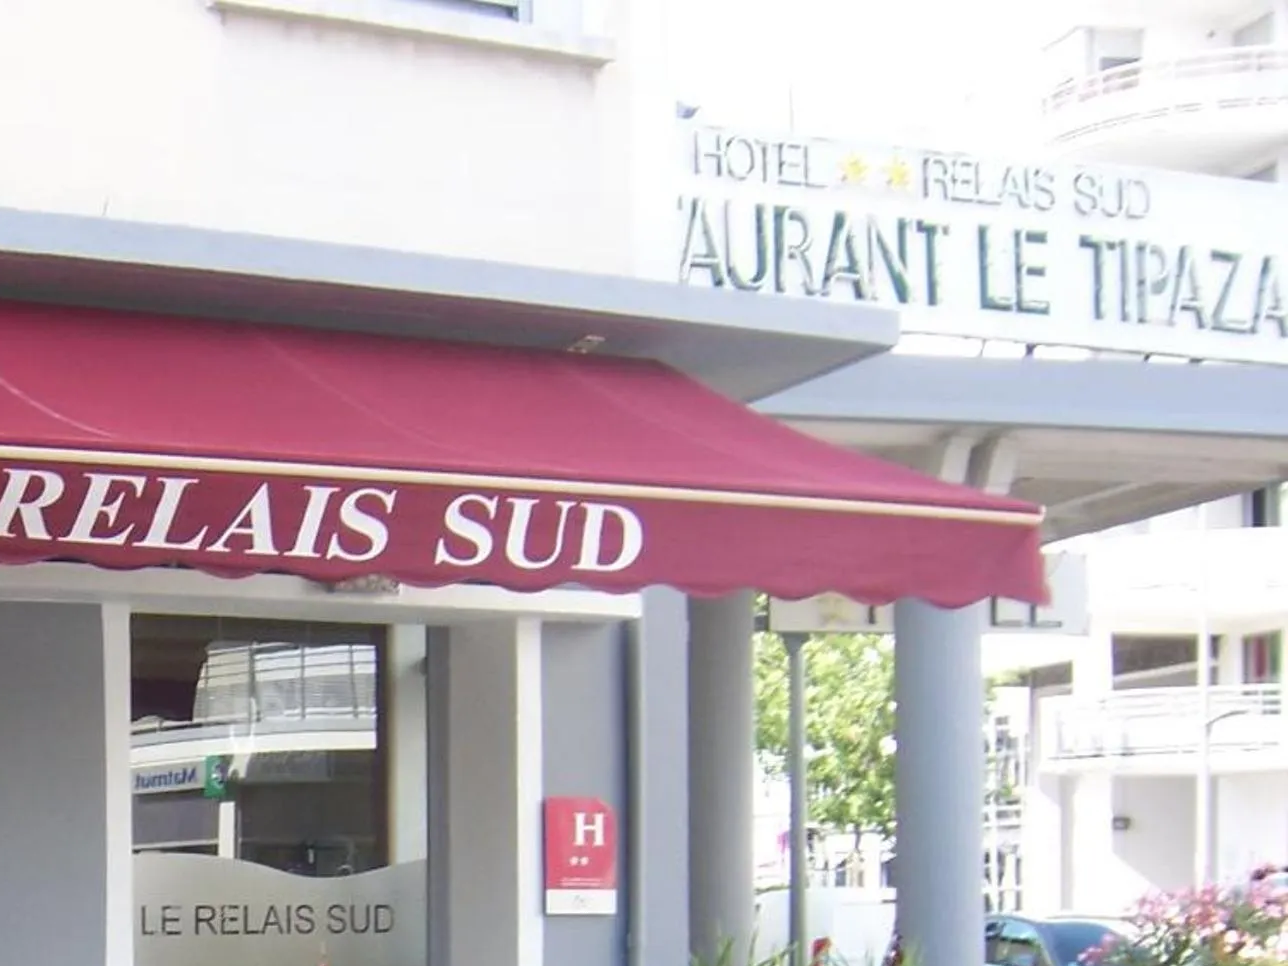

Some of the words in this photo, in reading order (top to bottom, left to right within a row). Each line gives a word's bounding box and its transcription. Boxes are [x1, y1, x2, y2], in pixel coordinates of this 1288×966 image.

[693, 130, 828, 188] HOTEL
[922, 156, 1056, 212] RELAIS
[1073, 171, 1150, 219] SUD
[677, 196, 950, 306] AURANT
[978, 223, 1050, 316] LE
[1079, 234, 1288, 338] TIPAZA
[434, 493, 644, 573] SUD
[573, 811, 605, 847] H
[140, 904, 183, 936] LE
[194, 904, 316, 936] RELAIS
[326, 904, 395, 936] SUD
